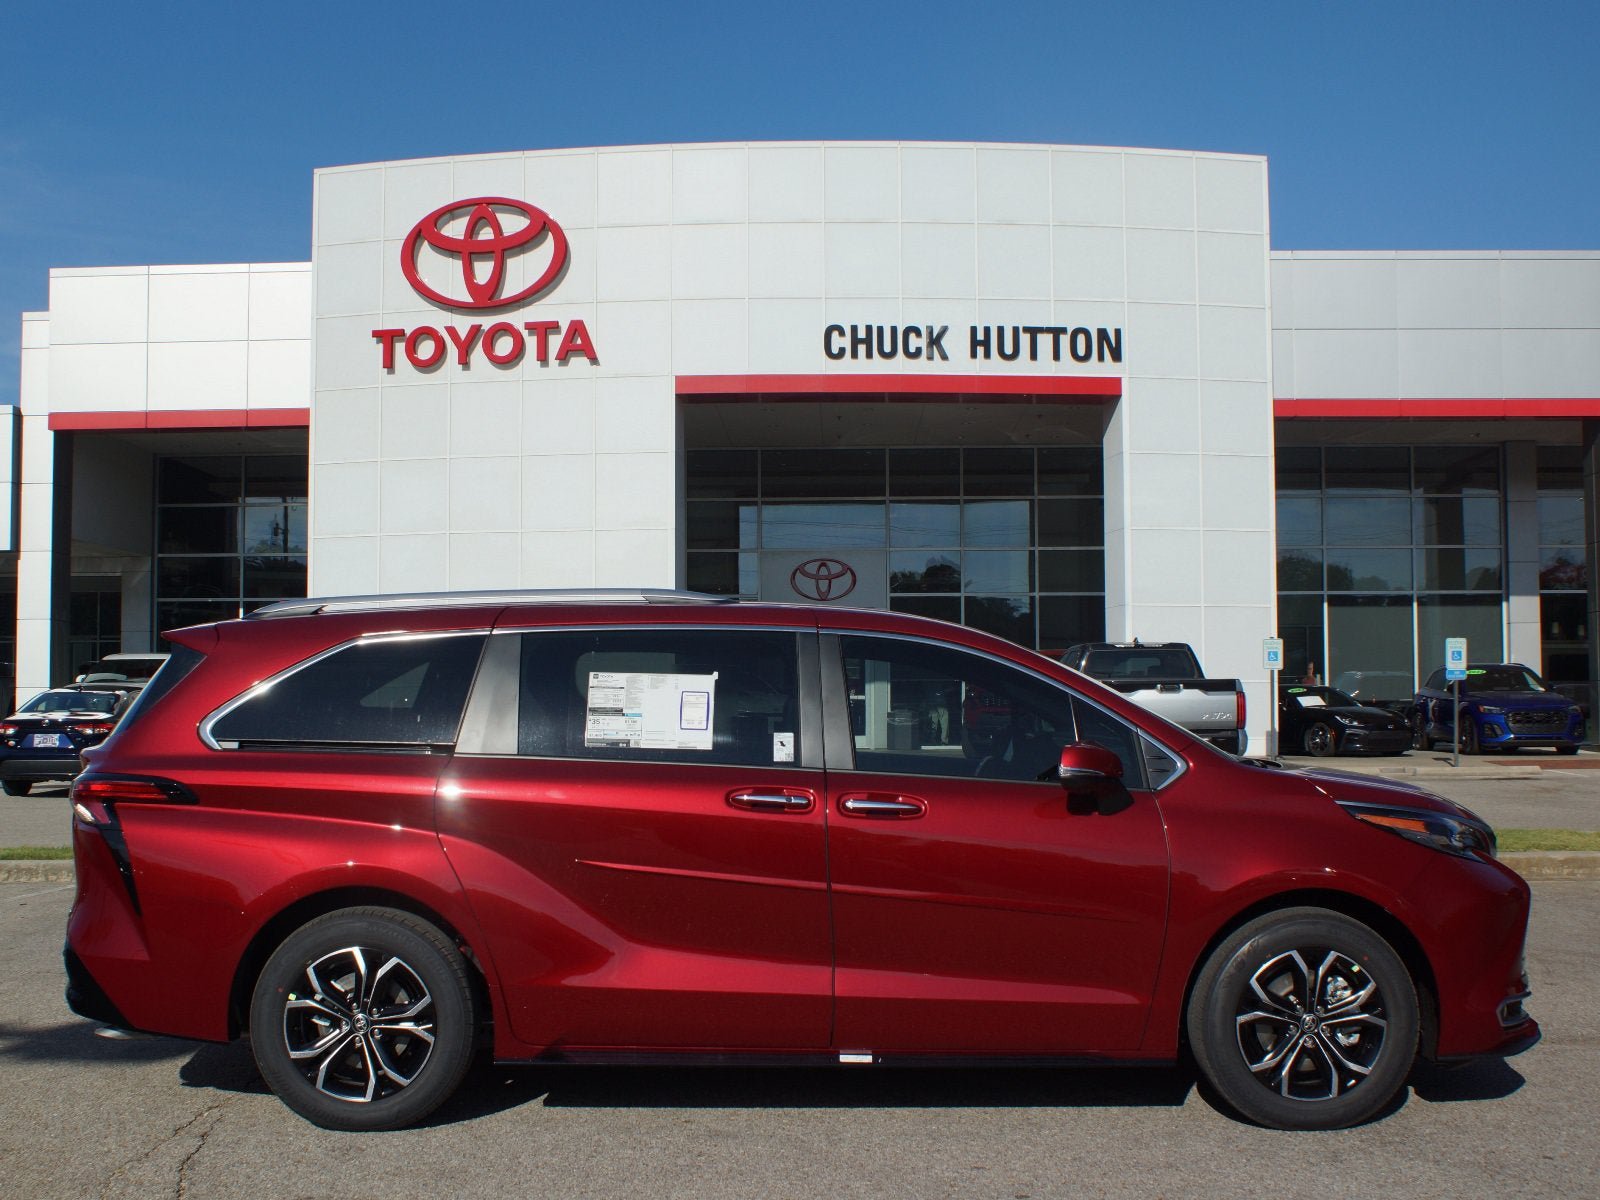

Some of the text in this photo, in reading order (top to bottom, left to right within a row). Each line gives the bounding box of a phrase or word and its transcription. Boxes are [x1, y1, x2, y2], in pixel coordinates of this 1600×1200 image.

[372, 319, 598, 369] TOYOTA
[823, 324, 1123, 363] CHUCK HUTTON
